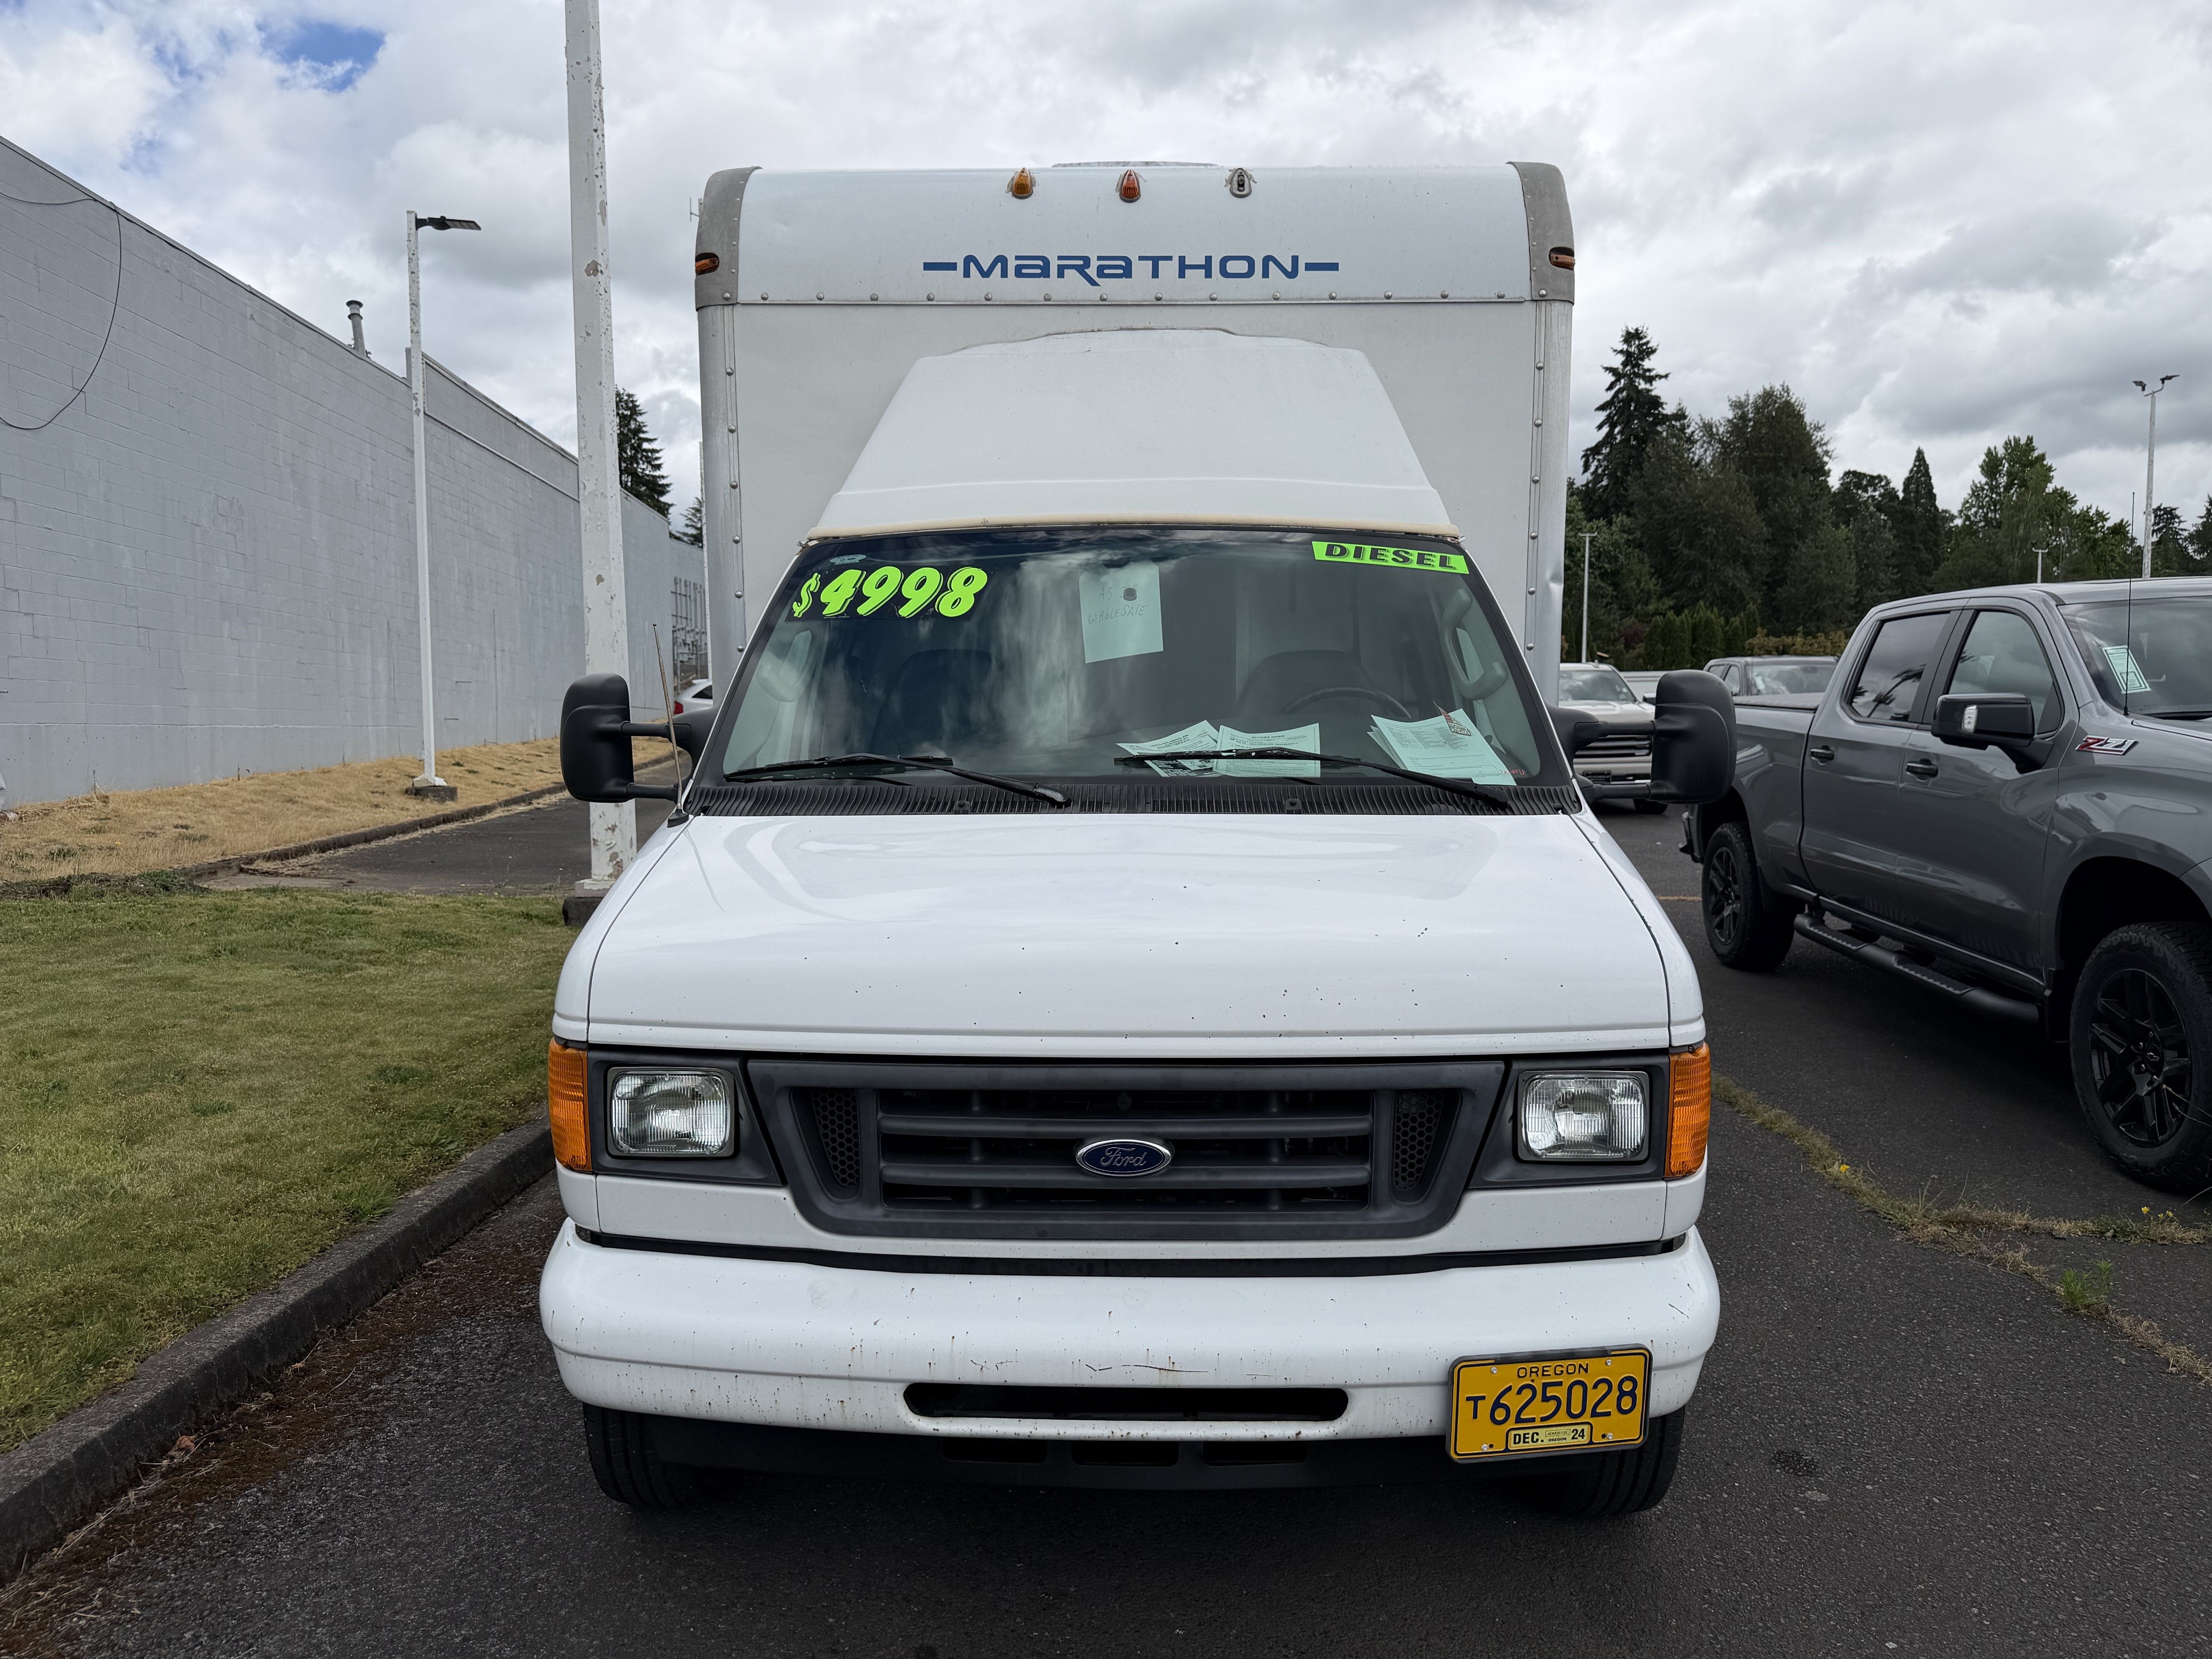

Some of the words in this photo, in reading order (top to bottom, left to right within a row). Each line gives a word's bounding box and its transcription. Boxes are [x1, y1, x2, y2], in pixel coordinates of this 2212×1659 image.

[1325, 543, 1455, 570] DIESEL
[792, 566, 988, 618] $4998
[1098, 587, 1113, 601] AS
[2075, 735, 2139, 755] Z71
[1100, 1147, 1147, 1166] Ford
[1517, 1363, 1589, 1379] OREGON
[1466, 1375, 1638, 1425] T625028
[1513, 1432, 1544, 1444] DEC.
[1571, 1428, 1585, 1440] 24
